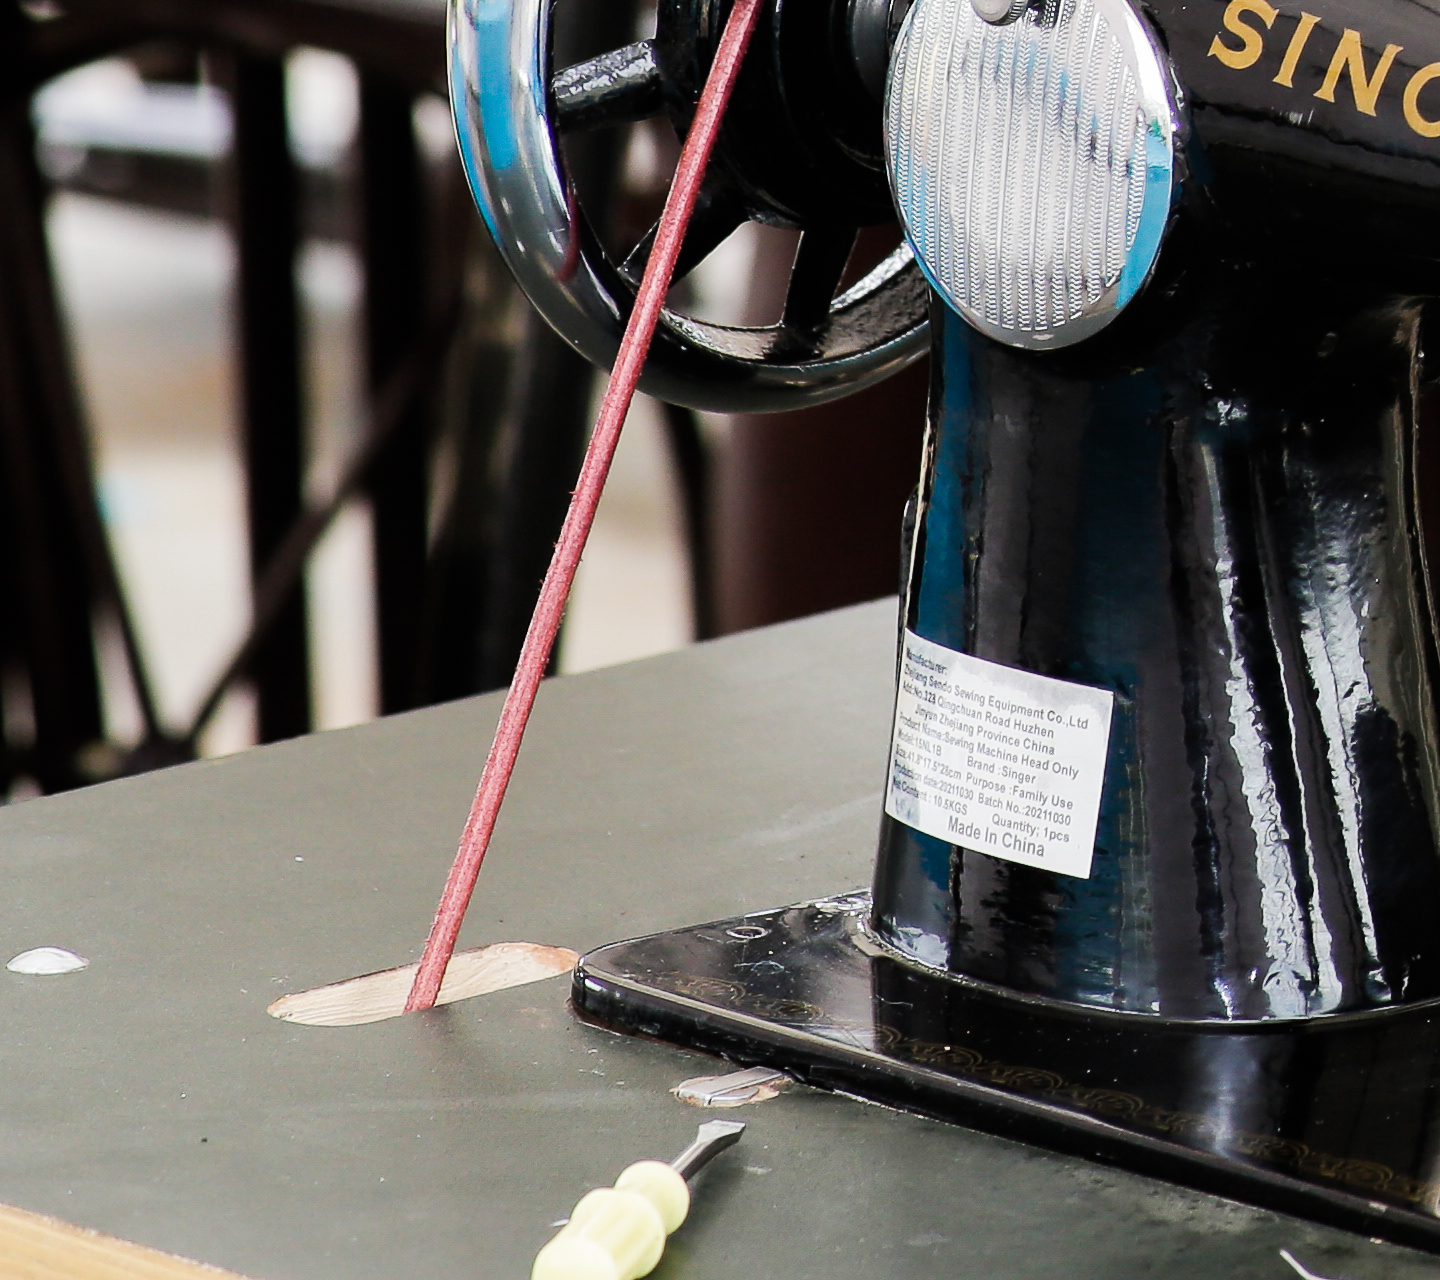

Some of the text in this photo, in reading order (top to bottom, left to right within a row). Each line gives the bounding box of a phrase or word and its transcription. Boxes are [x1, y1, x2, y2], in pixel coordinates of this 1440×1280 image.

[955, 682, 985, 706] Sewing
[988, 695, 1045, 720] Equipment
[939, 714, 974, 737] Zhejiang
[977, 725, 1020, 747] Province
[1023, 738, 1055, 755] China
[985, 711, 1010, 729] Road
[1014, 720, 1054, 738] Huzhen
[967, 756, 994, 774] Brand
[977, 743, 1018, 763] Machine
[1021, 755, 1050, 771] Head
[1052, 761, 1079, 780] Only
[966, 772, 1005, 795] Purpose
[1052, 795, 1073, 810] Use
[978, 793, 1003, 810] Batch
[948, 816, 1045, 857] Made In China
